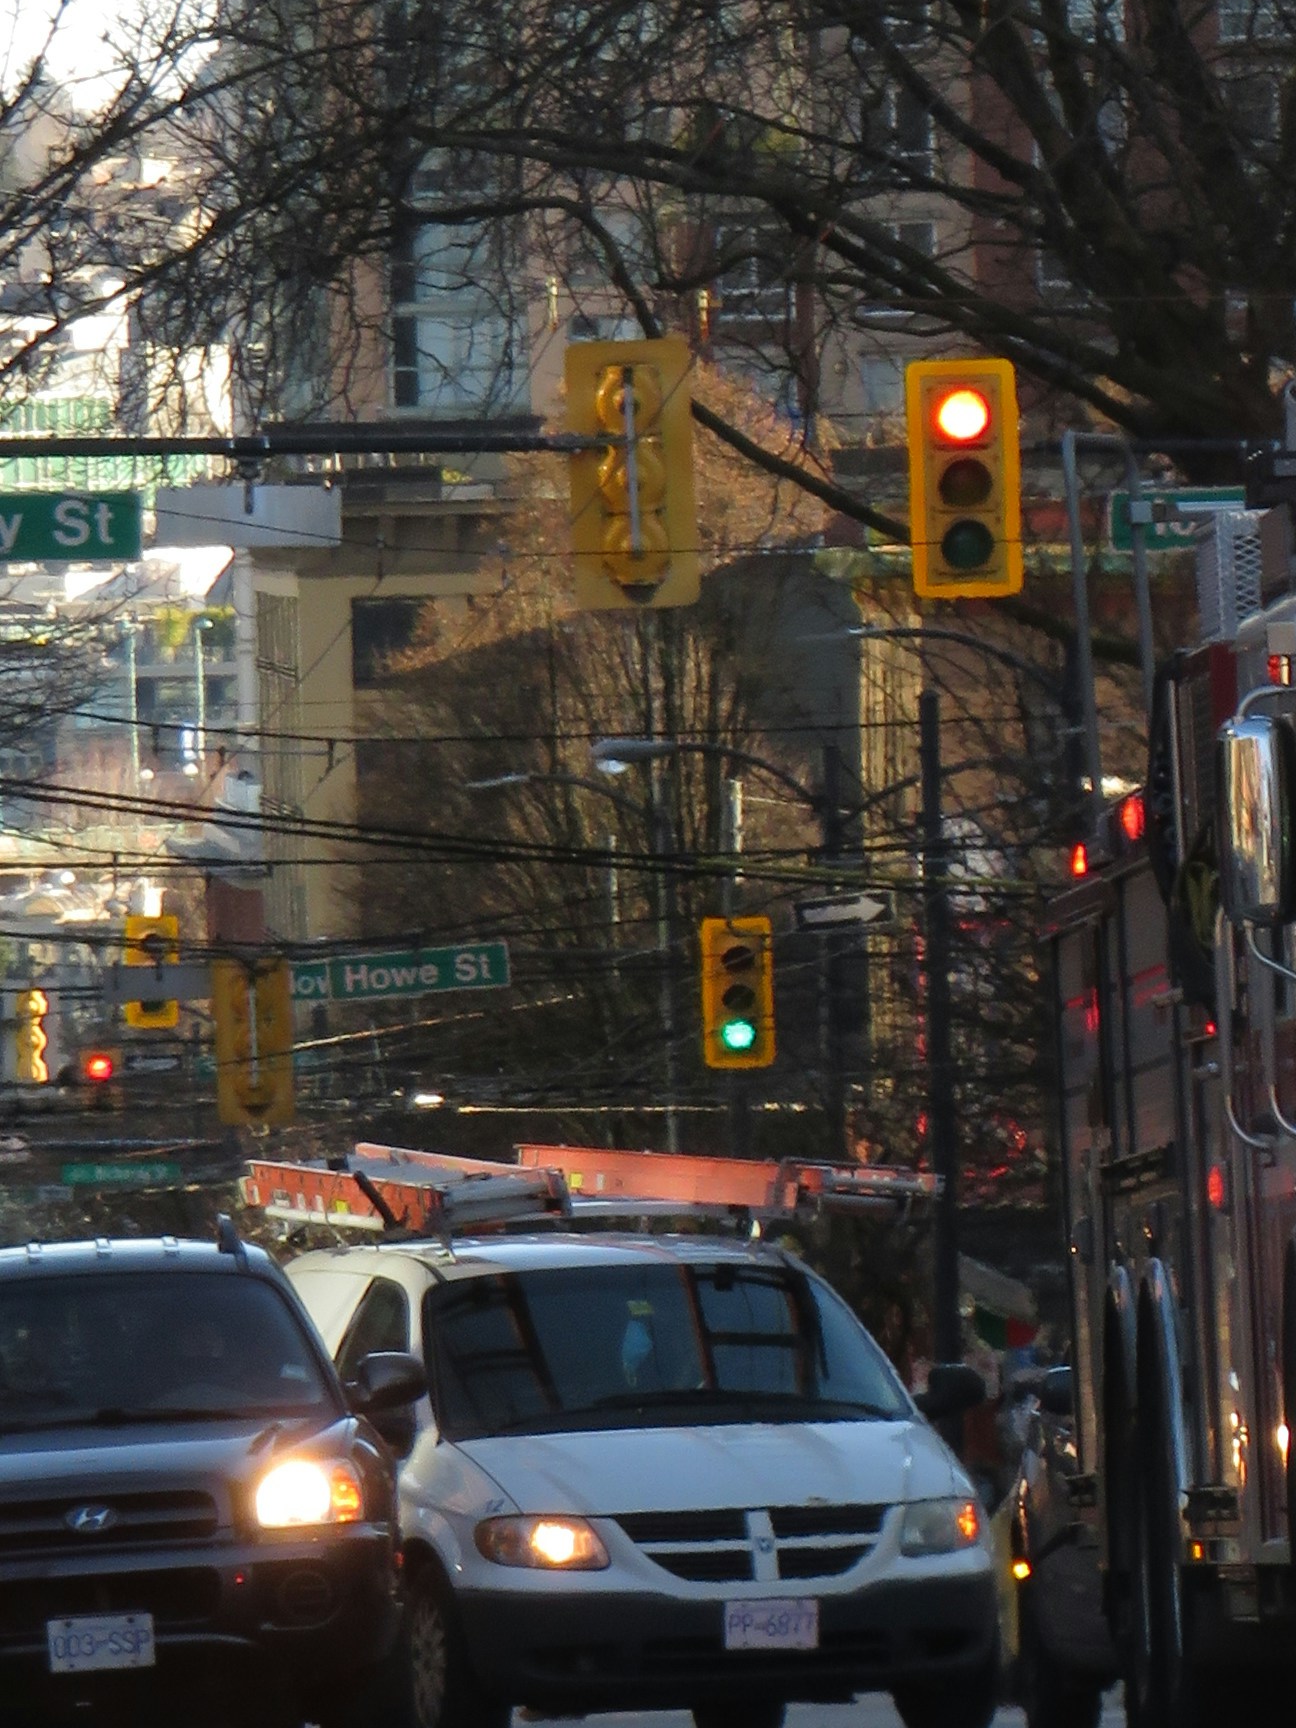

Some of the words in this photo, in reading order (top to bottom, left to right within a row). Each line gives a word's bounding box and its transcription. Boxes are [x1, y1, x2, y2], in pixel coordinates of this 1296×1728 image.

[53, 499, 115, 546] St
[344, 963, 439, 993] Howe
[454, 952, 491, 982] St
